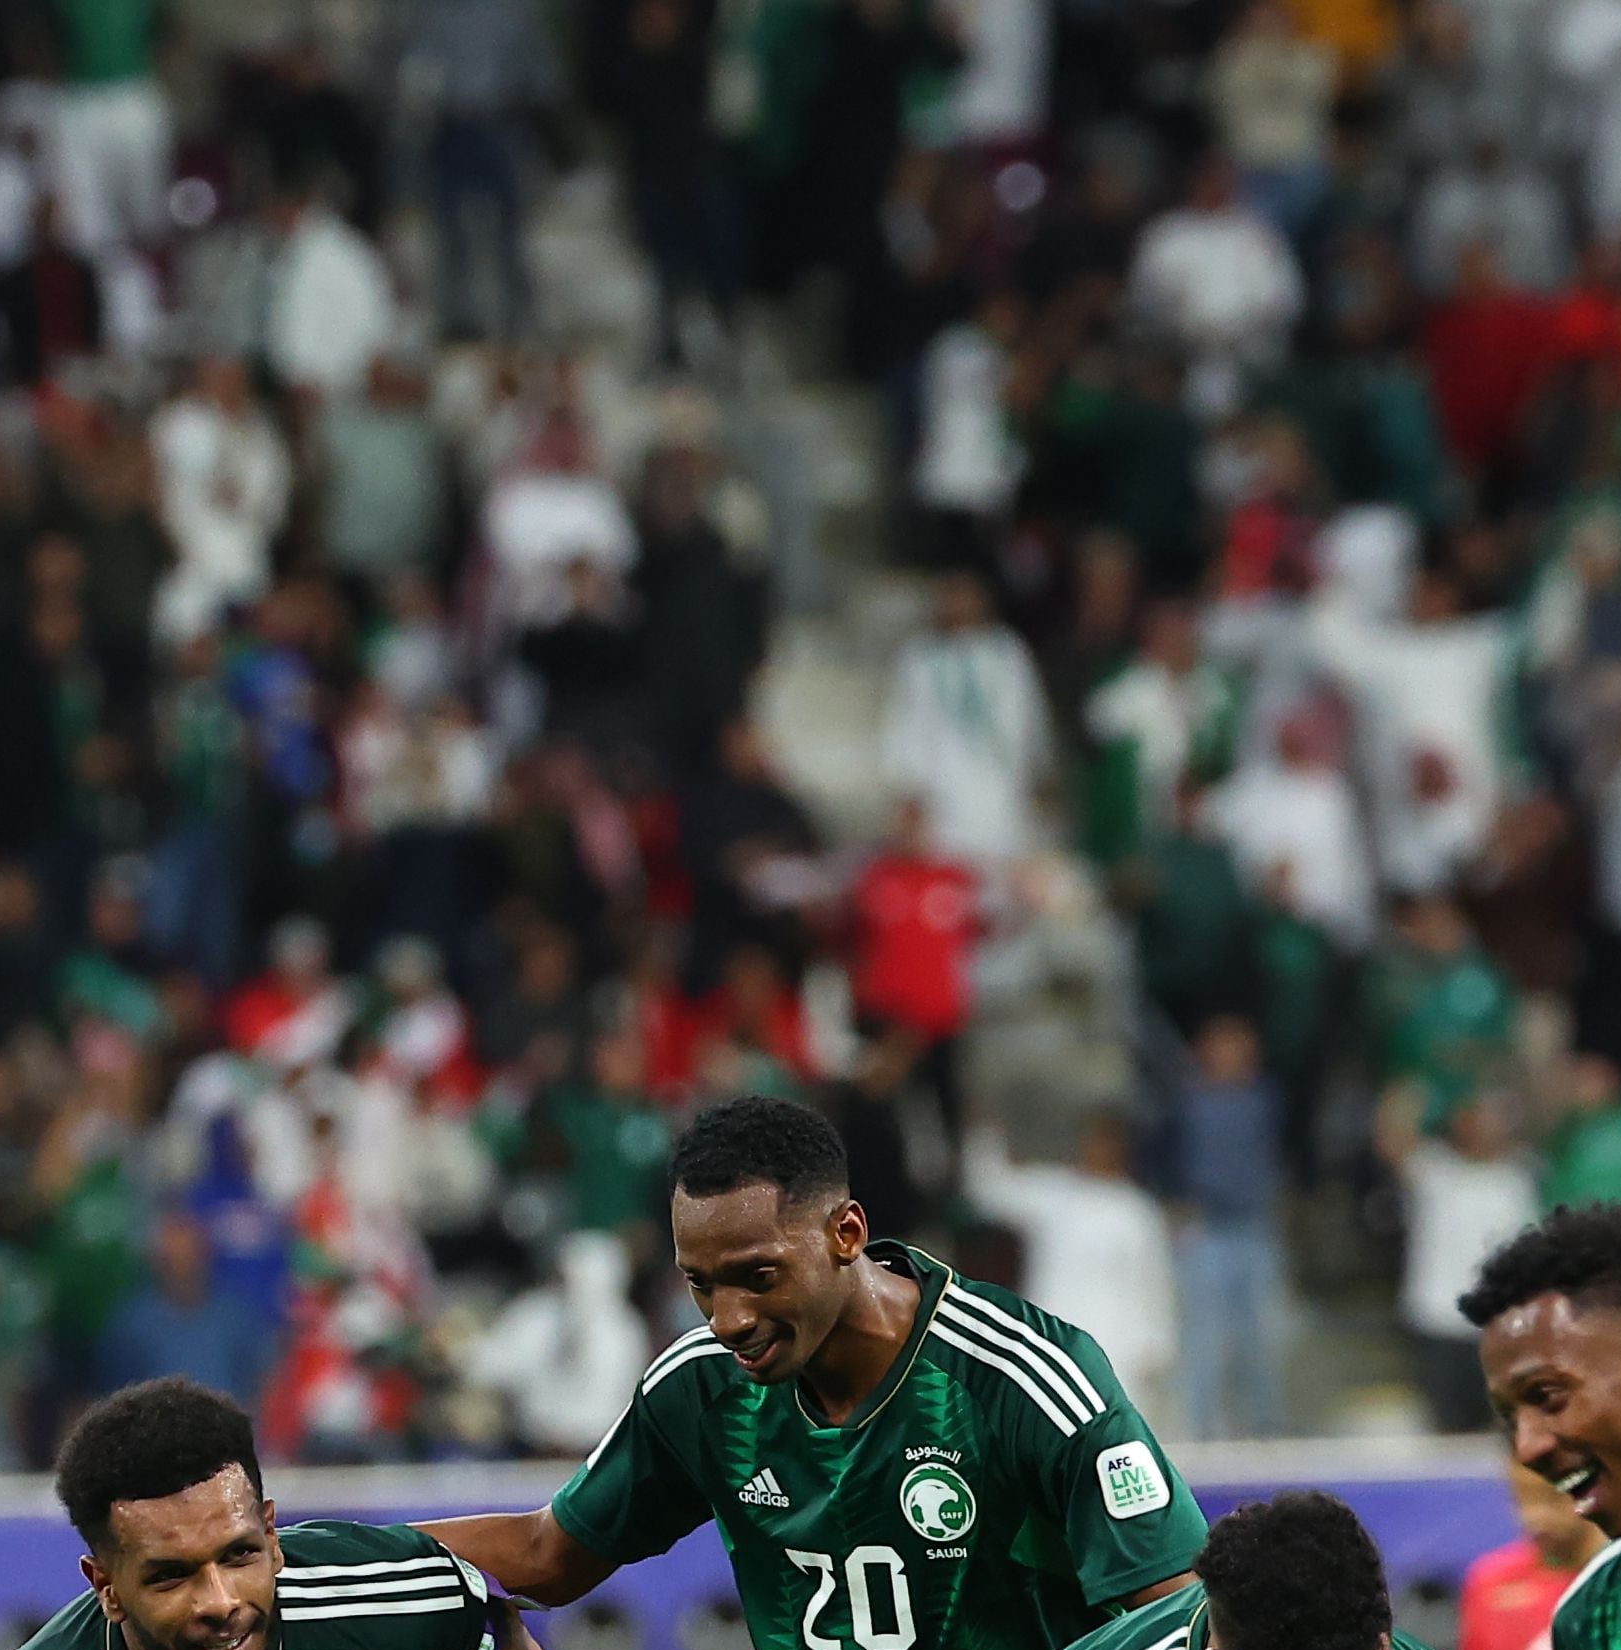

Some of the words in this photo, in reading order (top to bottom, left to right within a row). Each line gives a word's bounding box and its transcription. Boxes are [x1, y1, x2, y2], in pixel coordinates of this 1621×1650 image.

[905, 1445, 961, 1464] السعودية
[1108, 1456, 1132, 1472] AFC
[1109, 1466, 1152, 1490] LIVE
[739, 1489, 790, 1508] adidas
[941, 1510, 963, 1521] SAFF
[926, 1547, 967, 1560] SAUDI
